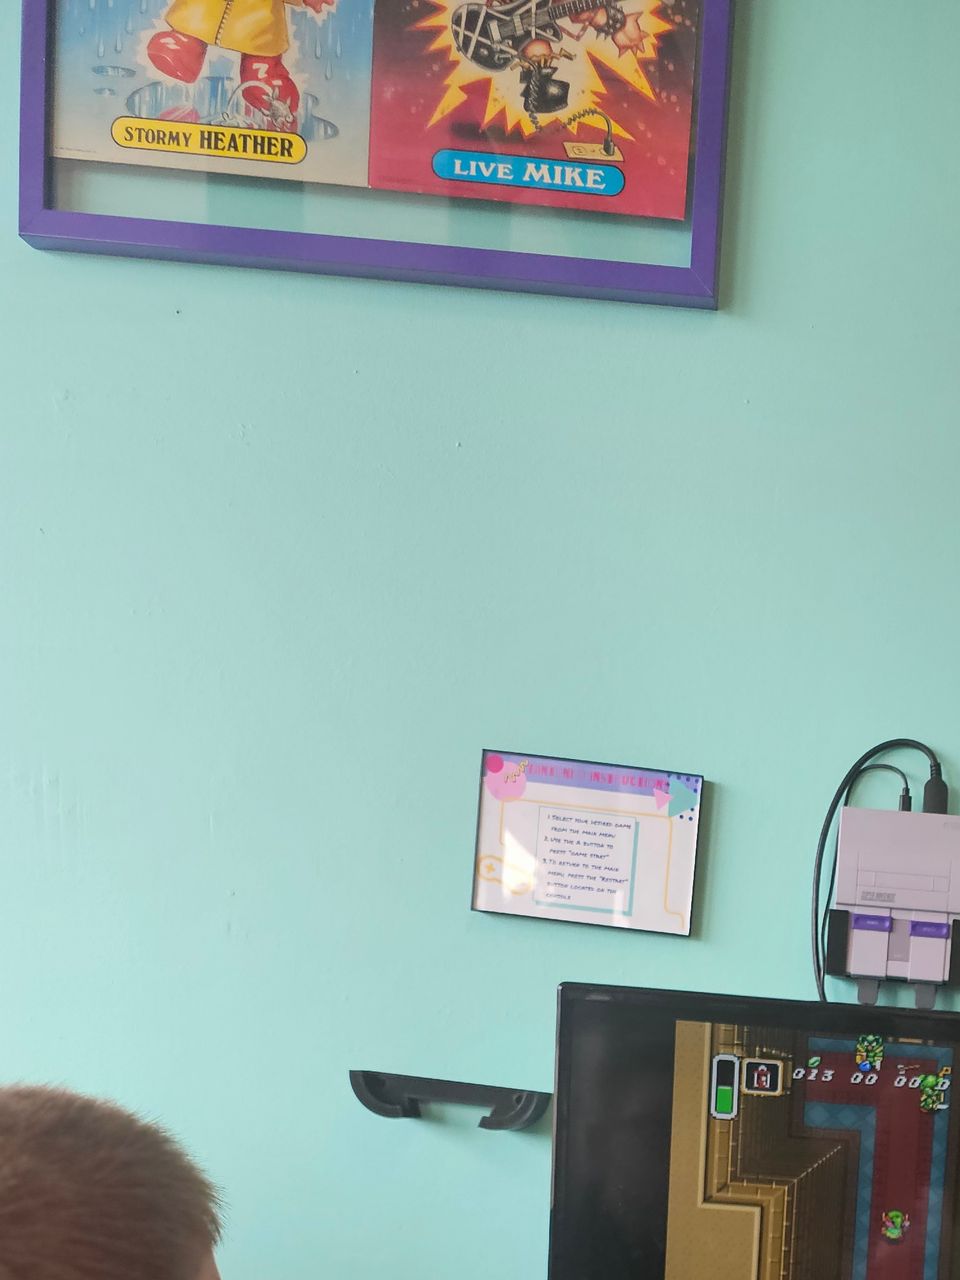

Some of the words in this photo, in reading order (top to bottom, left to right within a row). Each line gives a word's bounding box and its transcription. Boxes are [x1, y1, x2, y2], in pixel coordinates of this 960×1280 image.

[124, 126, 192, 148] STORMY
[200, 129, 294, 158] HEATHER
[454, 159, 513, 180] LIVE
[522, 162, 607, 190] MIKE
[793, 1068, 835, 1082] 013
[851, 1072, 878, 1085] 00
